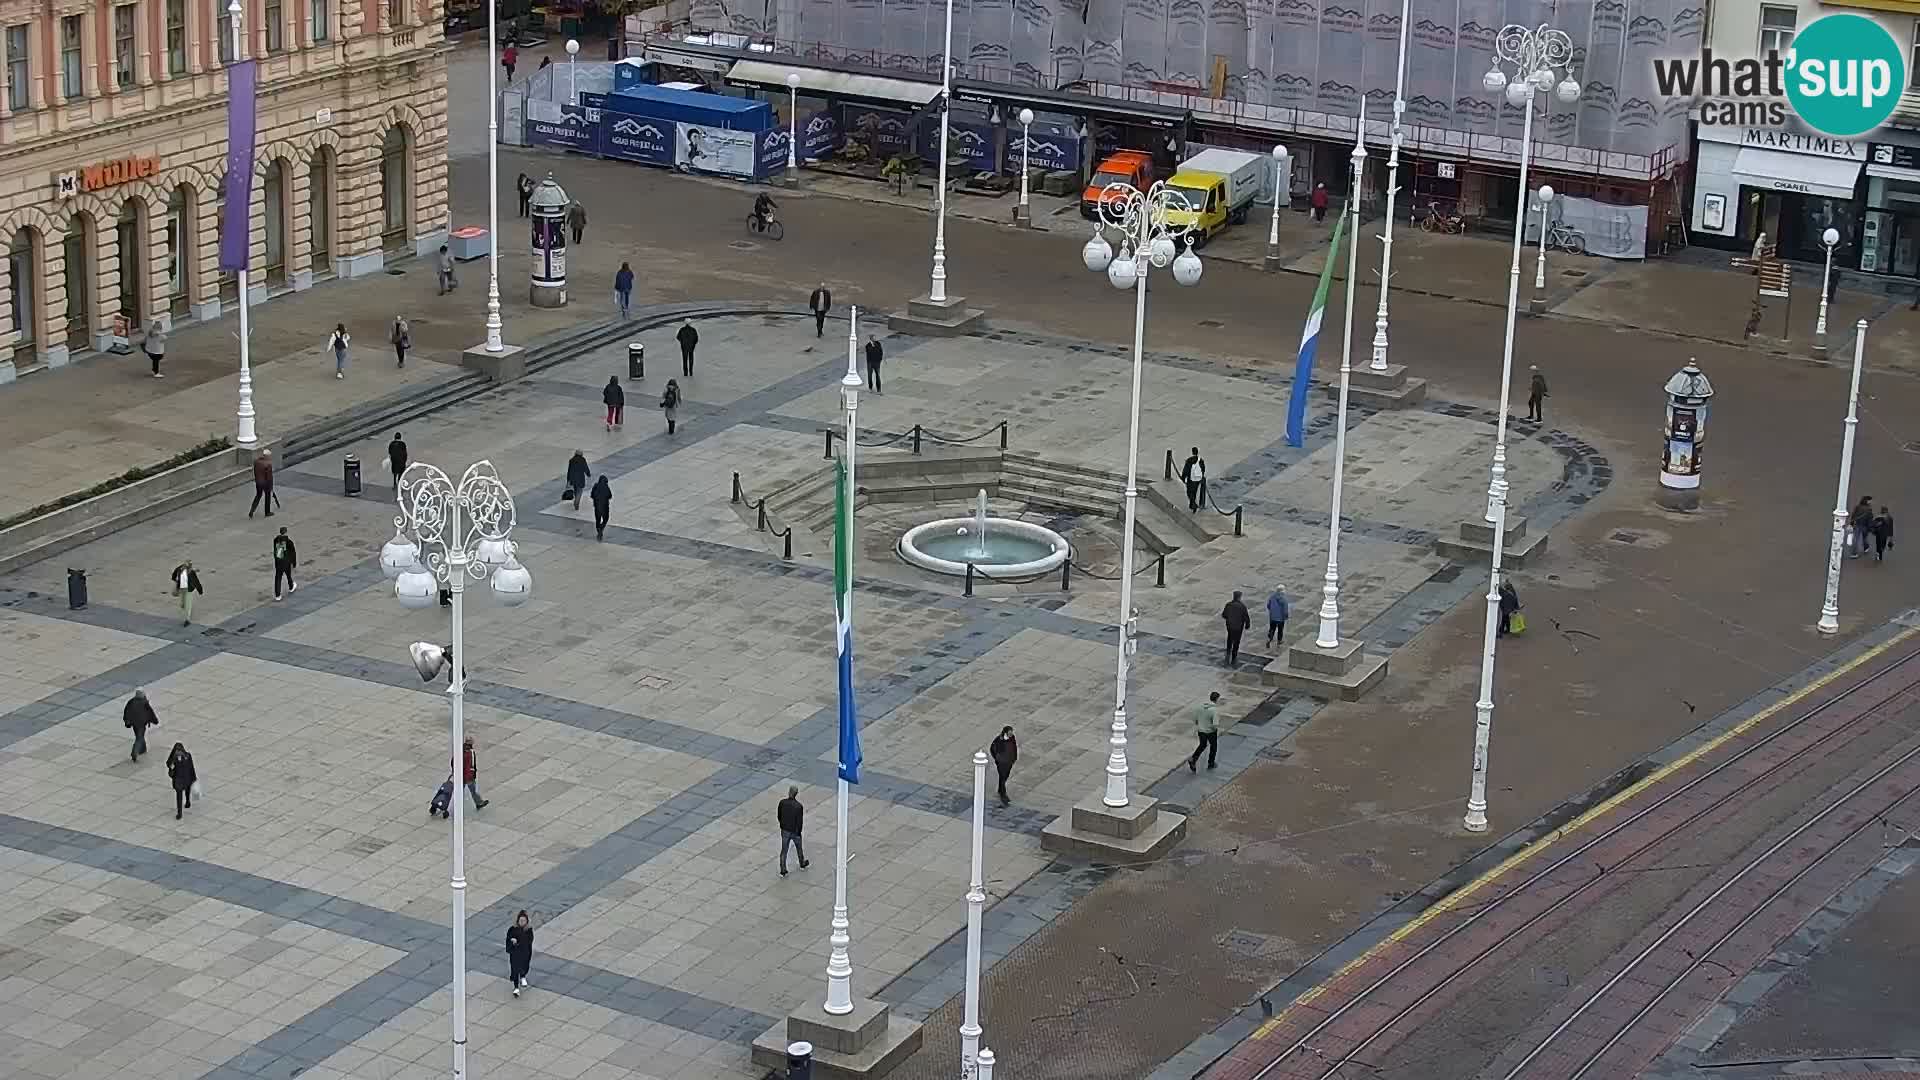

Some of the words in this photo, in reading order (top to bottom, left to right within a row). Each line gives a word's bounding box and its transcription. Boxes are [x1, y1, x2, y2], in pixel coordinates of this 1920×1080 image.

[1746, 129, 1856, 156] MARTIMEX
[82, 154, 160, 192] Müller
[1774, 181, 1809, 191] CHANEL
